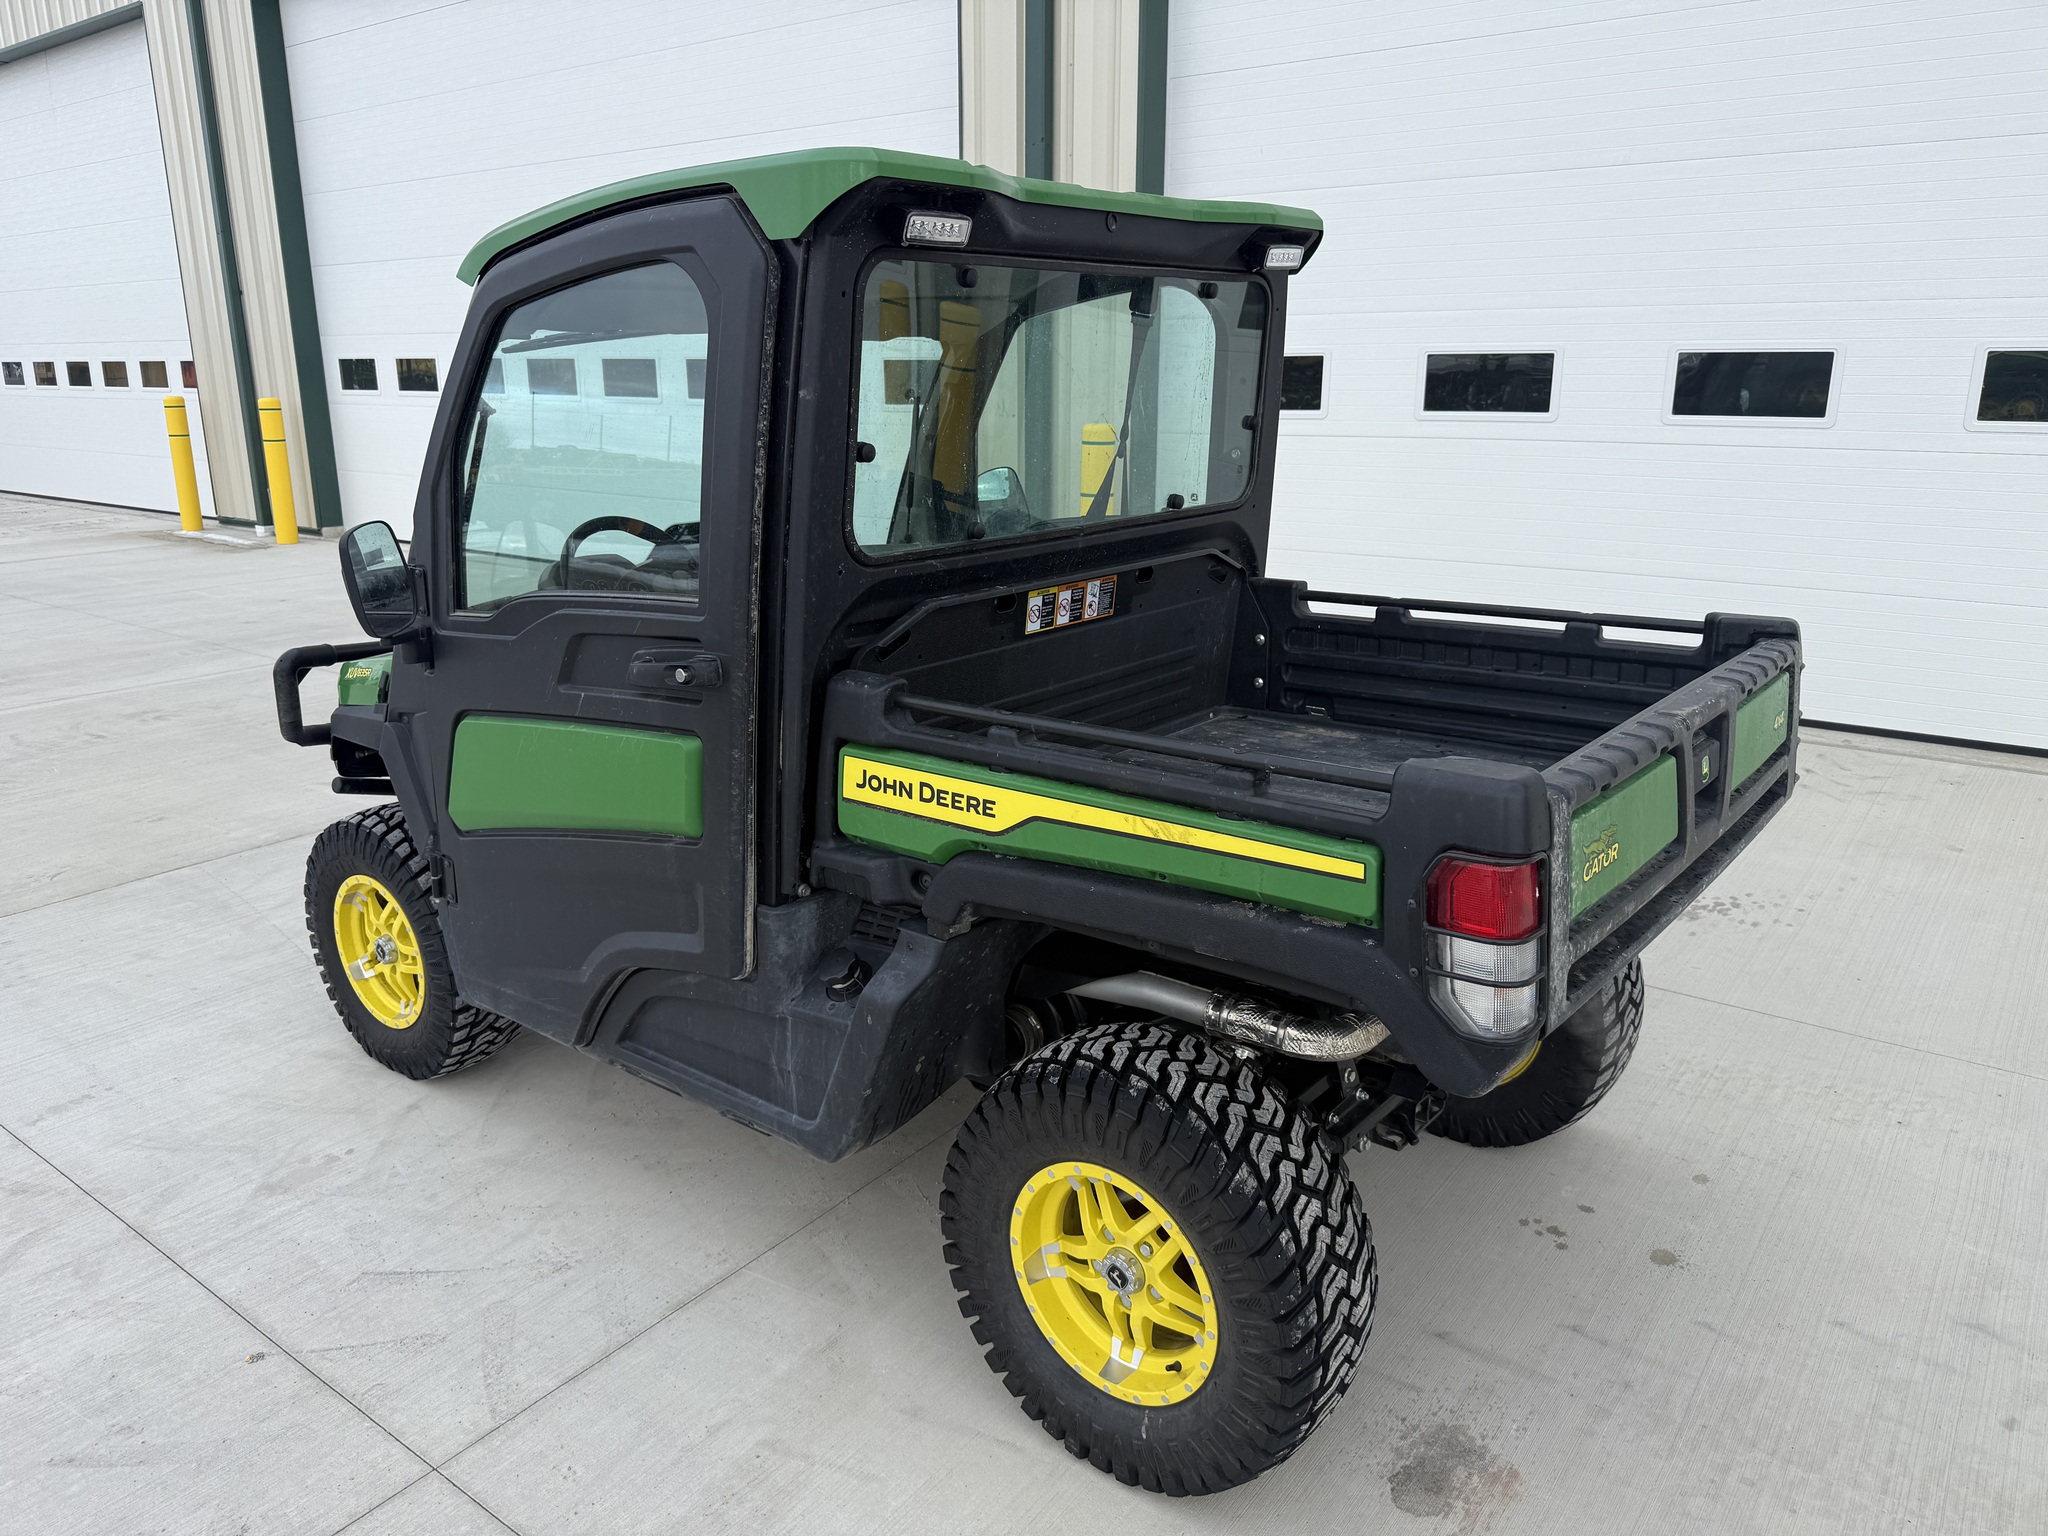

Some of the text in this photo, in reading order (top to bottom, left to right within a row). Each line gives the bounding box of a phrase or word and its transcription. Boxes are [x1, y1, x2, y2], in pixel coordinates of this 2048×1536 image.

[856, 769, 996, 818] JOHN DEERE
[1583, 842, 1619, 882] GATOR
